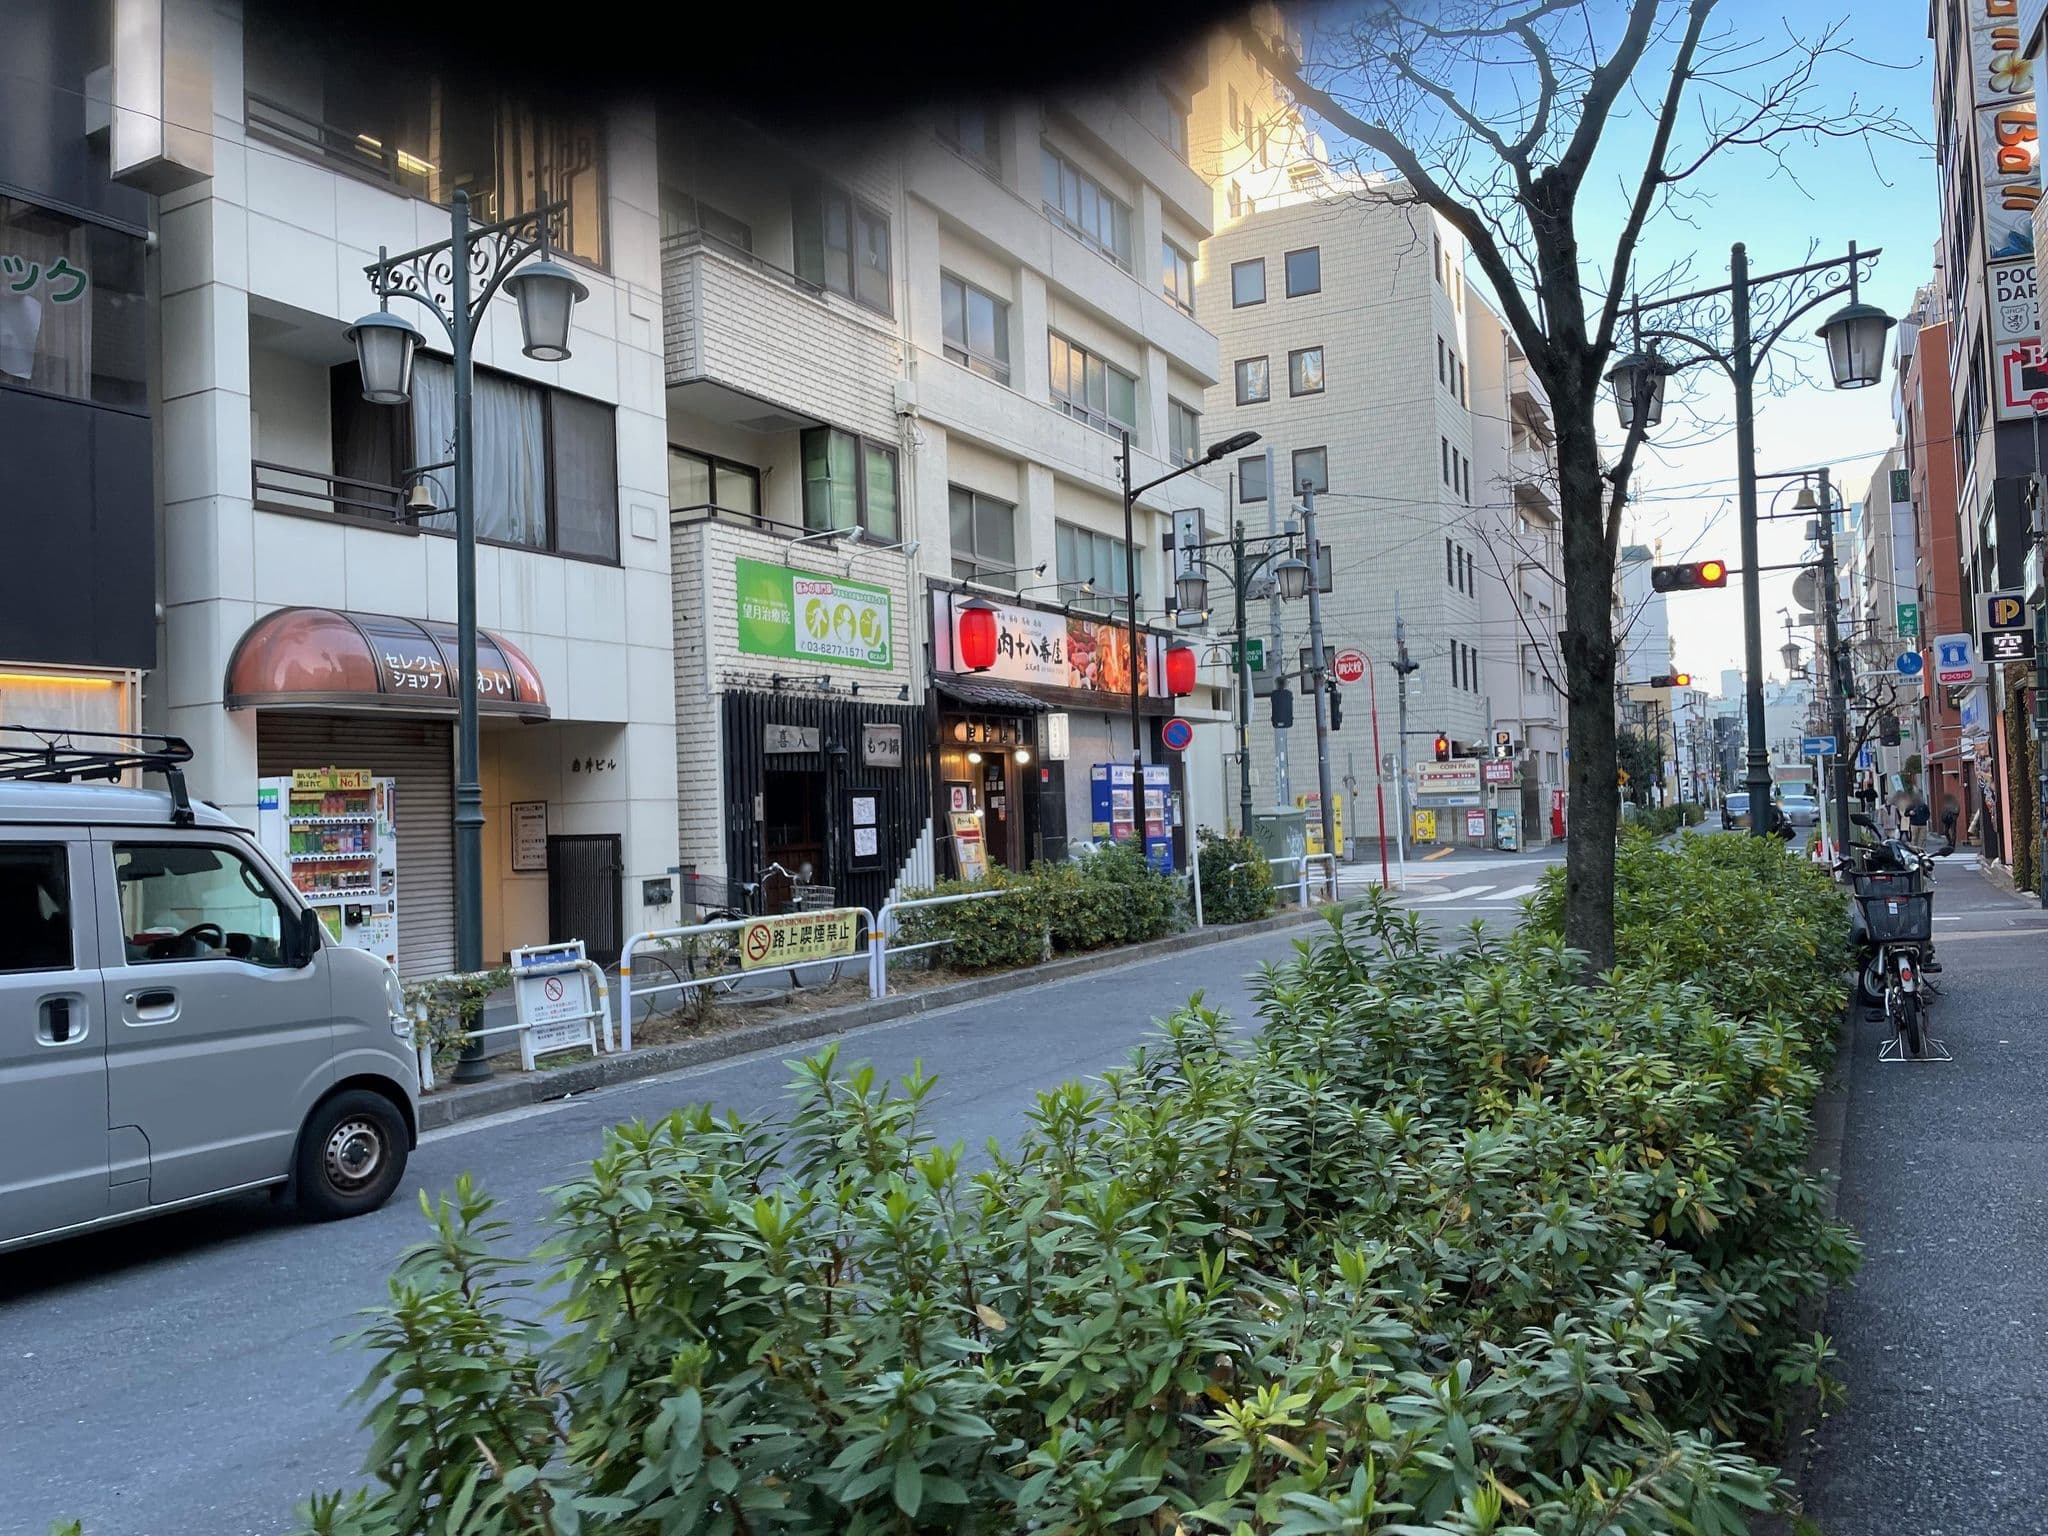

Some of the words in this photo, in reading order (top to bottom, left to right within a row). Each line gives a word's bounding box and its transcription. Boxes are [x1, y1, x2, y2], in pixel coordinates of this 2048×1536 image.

[743, 603, 791, 624] 望月治療院
[1998, 599, 2020, 624] P
[997, 626, 1063, 665] 肉十八番屋
[1994, 633, 2024, 657] 空
[386, 652, 441, 670] セレクト
[393, 670, 442, 690] ショップ
[1498, 732, 1508, 744] P
[340, 771, 361, 788] No.1
[772, 922, 850, 949] 路上喫煙禁止
